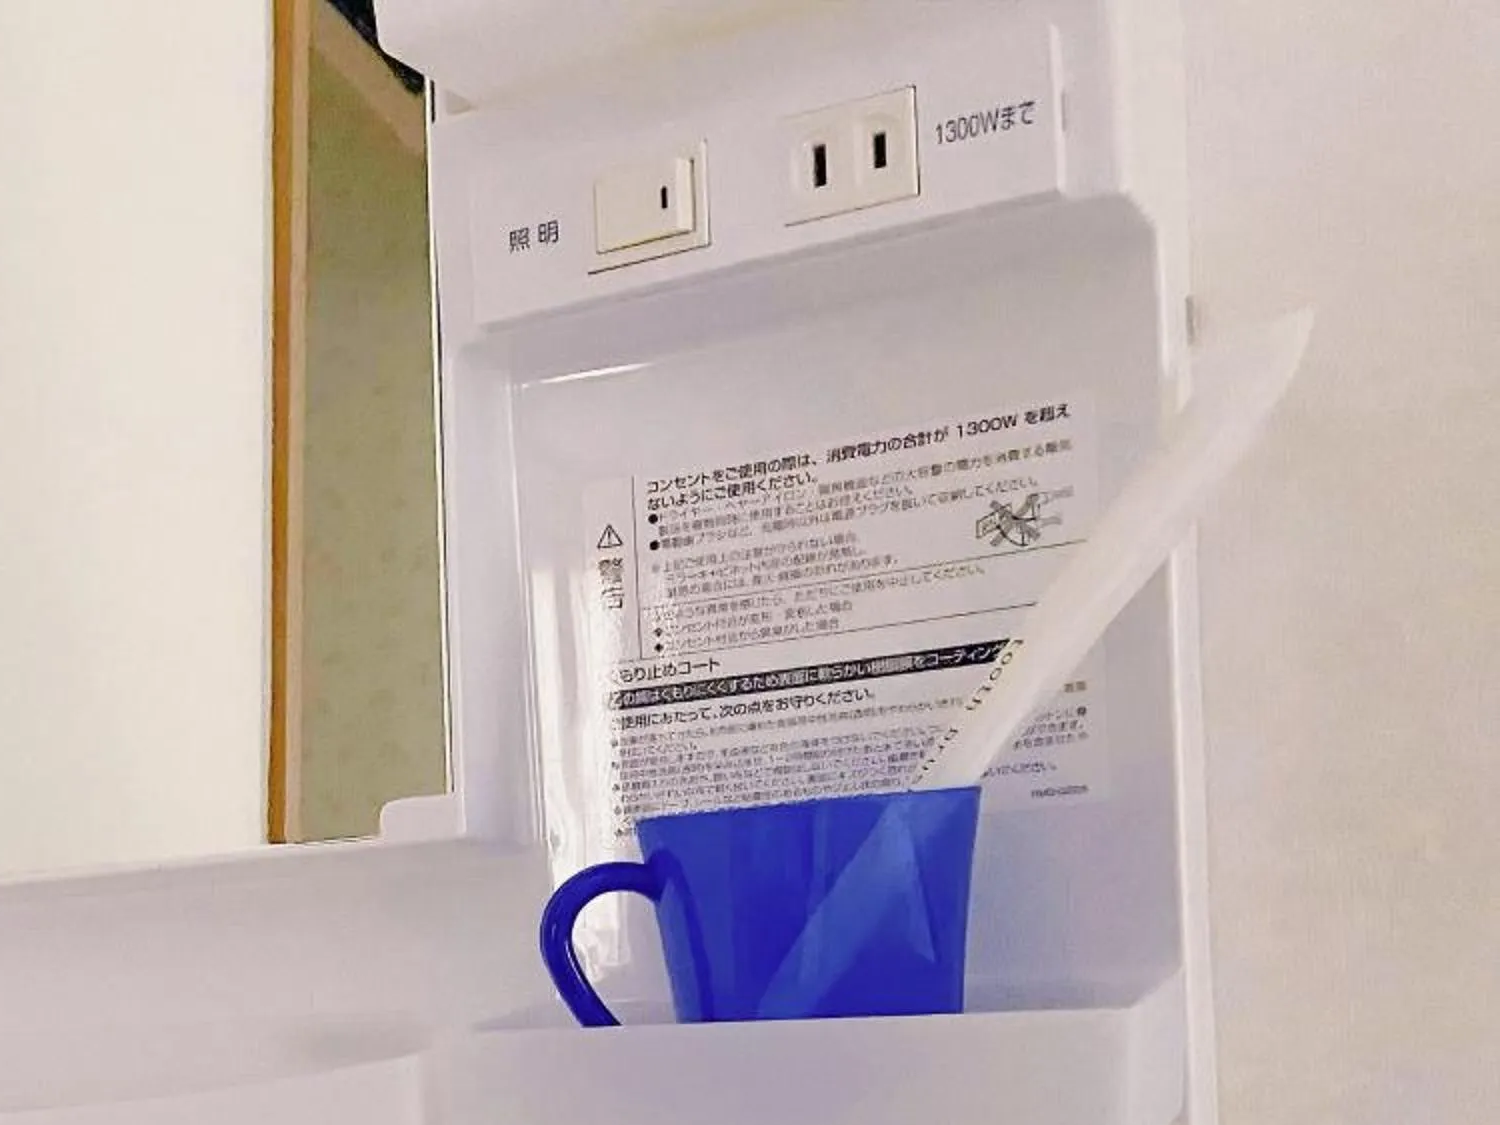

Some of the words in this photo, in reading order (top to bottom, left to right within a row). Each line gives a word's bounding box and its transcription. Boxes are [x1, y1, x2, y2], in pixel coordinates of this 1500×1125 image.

[934, 100, 1035, 145] 1300Wまで
[508, 220, 560, 253] 照明
[956, 413, 1018, 438] 1300W
[1024, 403, 1071, 425] を超え
